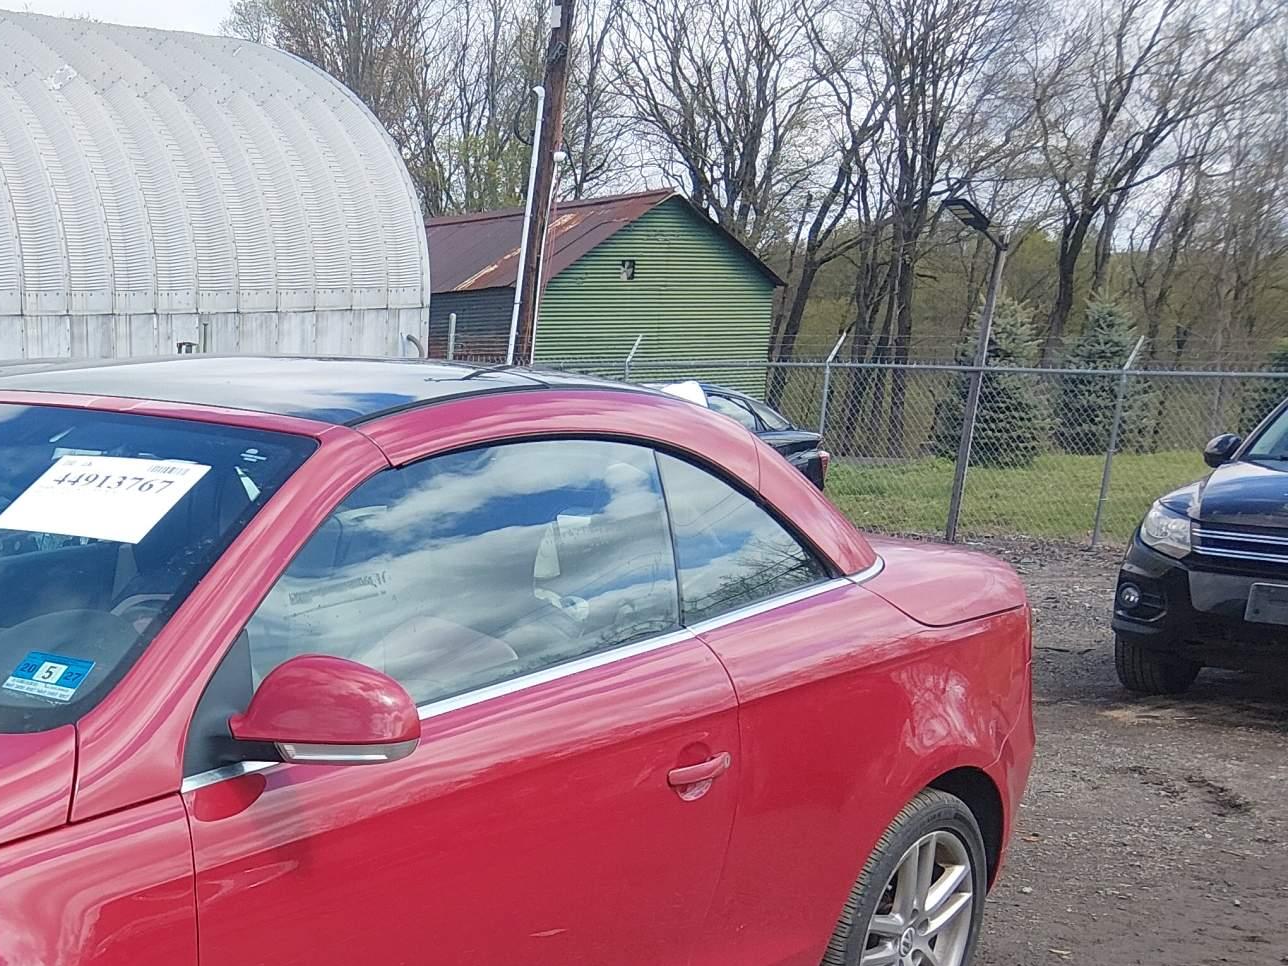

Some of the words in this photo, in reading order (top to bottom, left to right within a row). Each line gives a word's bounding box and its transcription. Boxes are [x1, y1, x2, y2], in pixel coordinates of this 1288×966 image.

[53, 472, 175, 494] 44913767
[20, 662, 37, 673] 20
[41, 665, 57, 680] 5
[63, 671, 82, 681] 27
